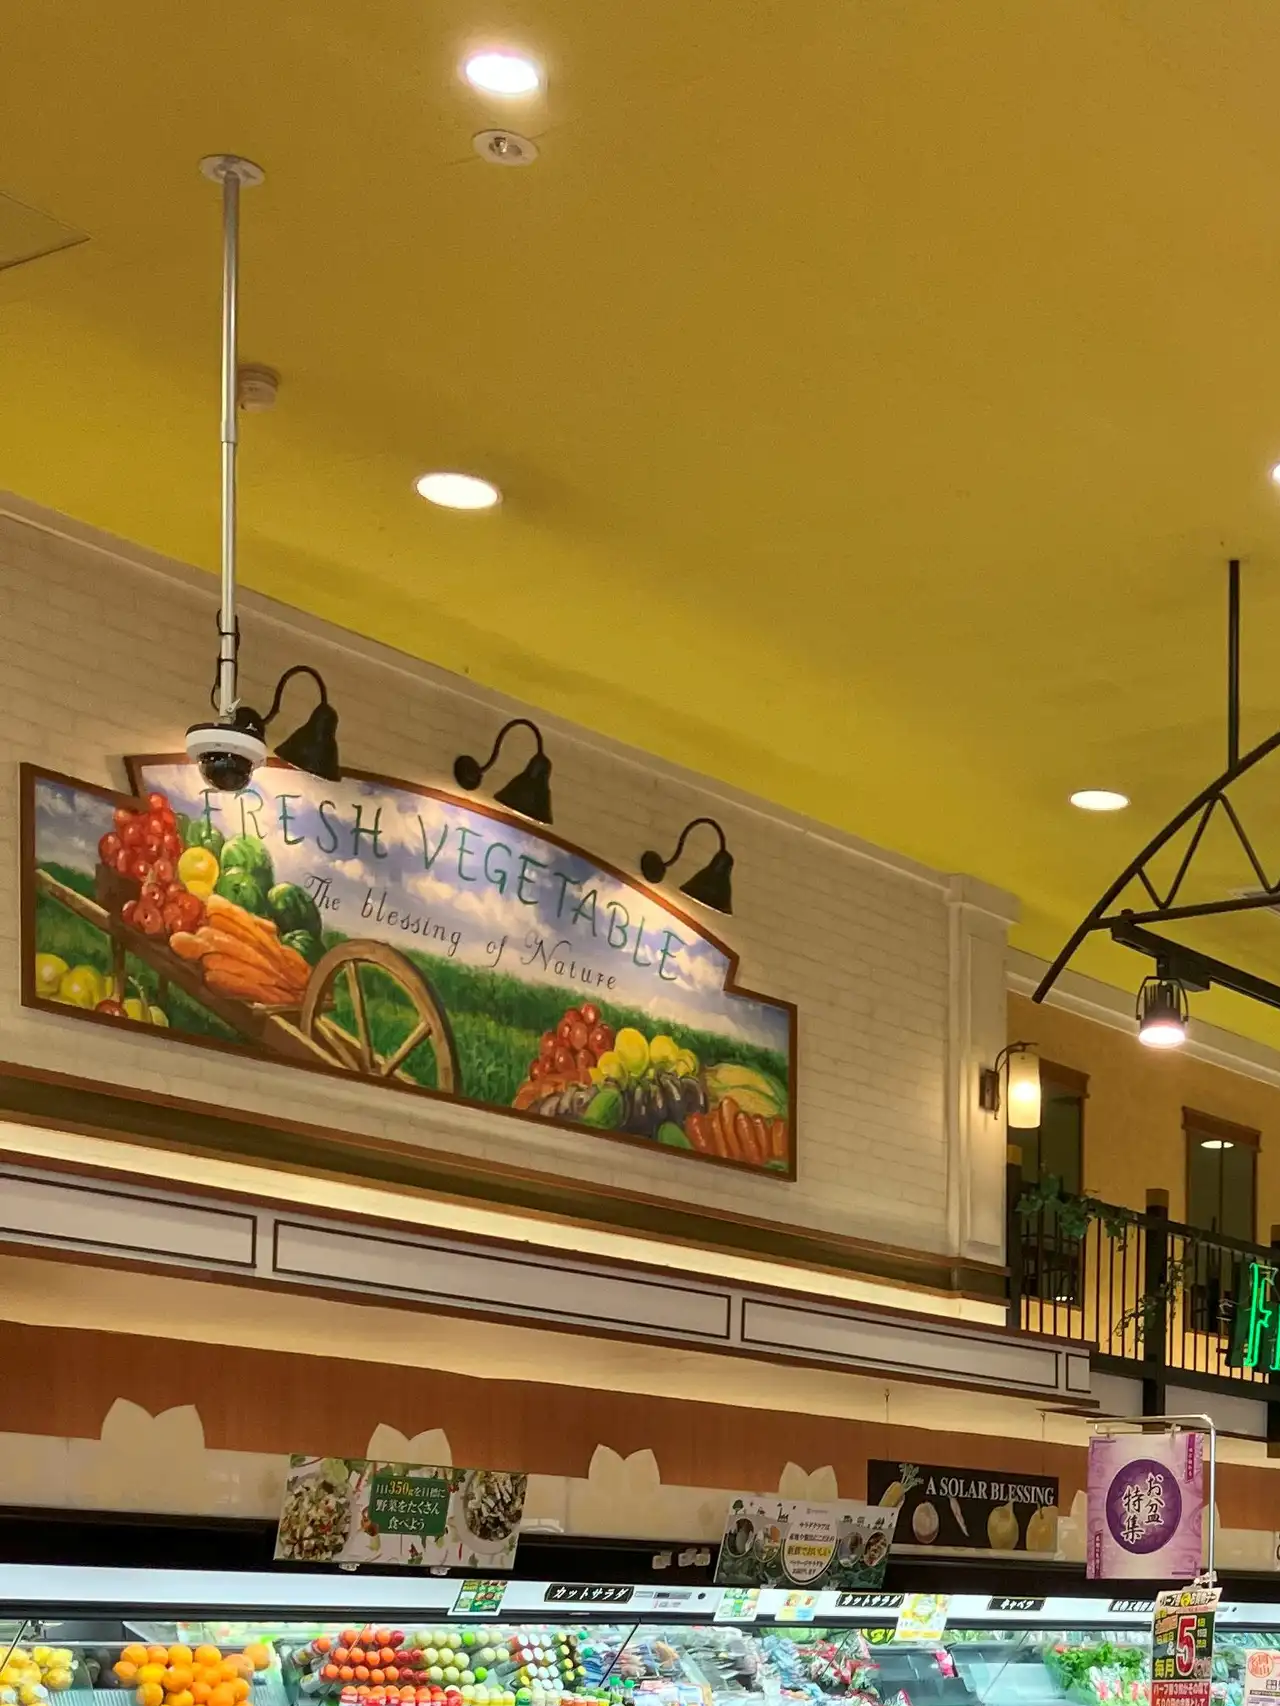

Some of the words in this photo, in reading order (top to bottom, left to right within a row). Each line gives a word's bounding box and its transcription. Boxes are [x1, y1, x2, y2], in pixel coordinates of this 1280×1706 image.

[200, 786, 388, 861] FRESH
[418, 814, 687, 983] VEGETABLE
[303, 872, 341, 914] The
[360, 885, 463, 959] blessing
[486, 932, 514, 976] of
[520, 937, 619, 991] Nature
[376, 1499, 440, 1515] 野菜をたくさん
[926, 1477, 936, 1495] A
[940, 1477, 989, 1500] SOLAR
[991, 1482, 1054, 1507] BLESSING
[1144, 1472, 1164, 1525] お盆
[388, 1516, 425, 1531] 食べよう
[1121, 1484, 1146, 1544] 特集
[552, 1584, 631, 1602] カットサラダ
[842, 1594, 902, 1607] カットサラダ
[1000, 1599, 1034, 1611] キャベツ
[1155, 1658, 1175, 1678] 毎月
[1175, 1614, 1198, 1677] 5
